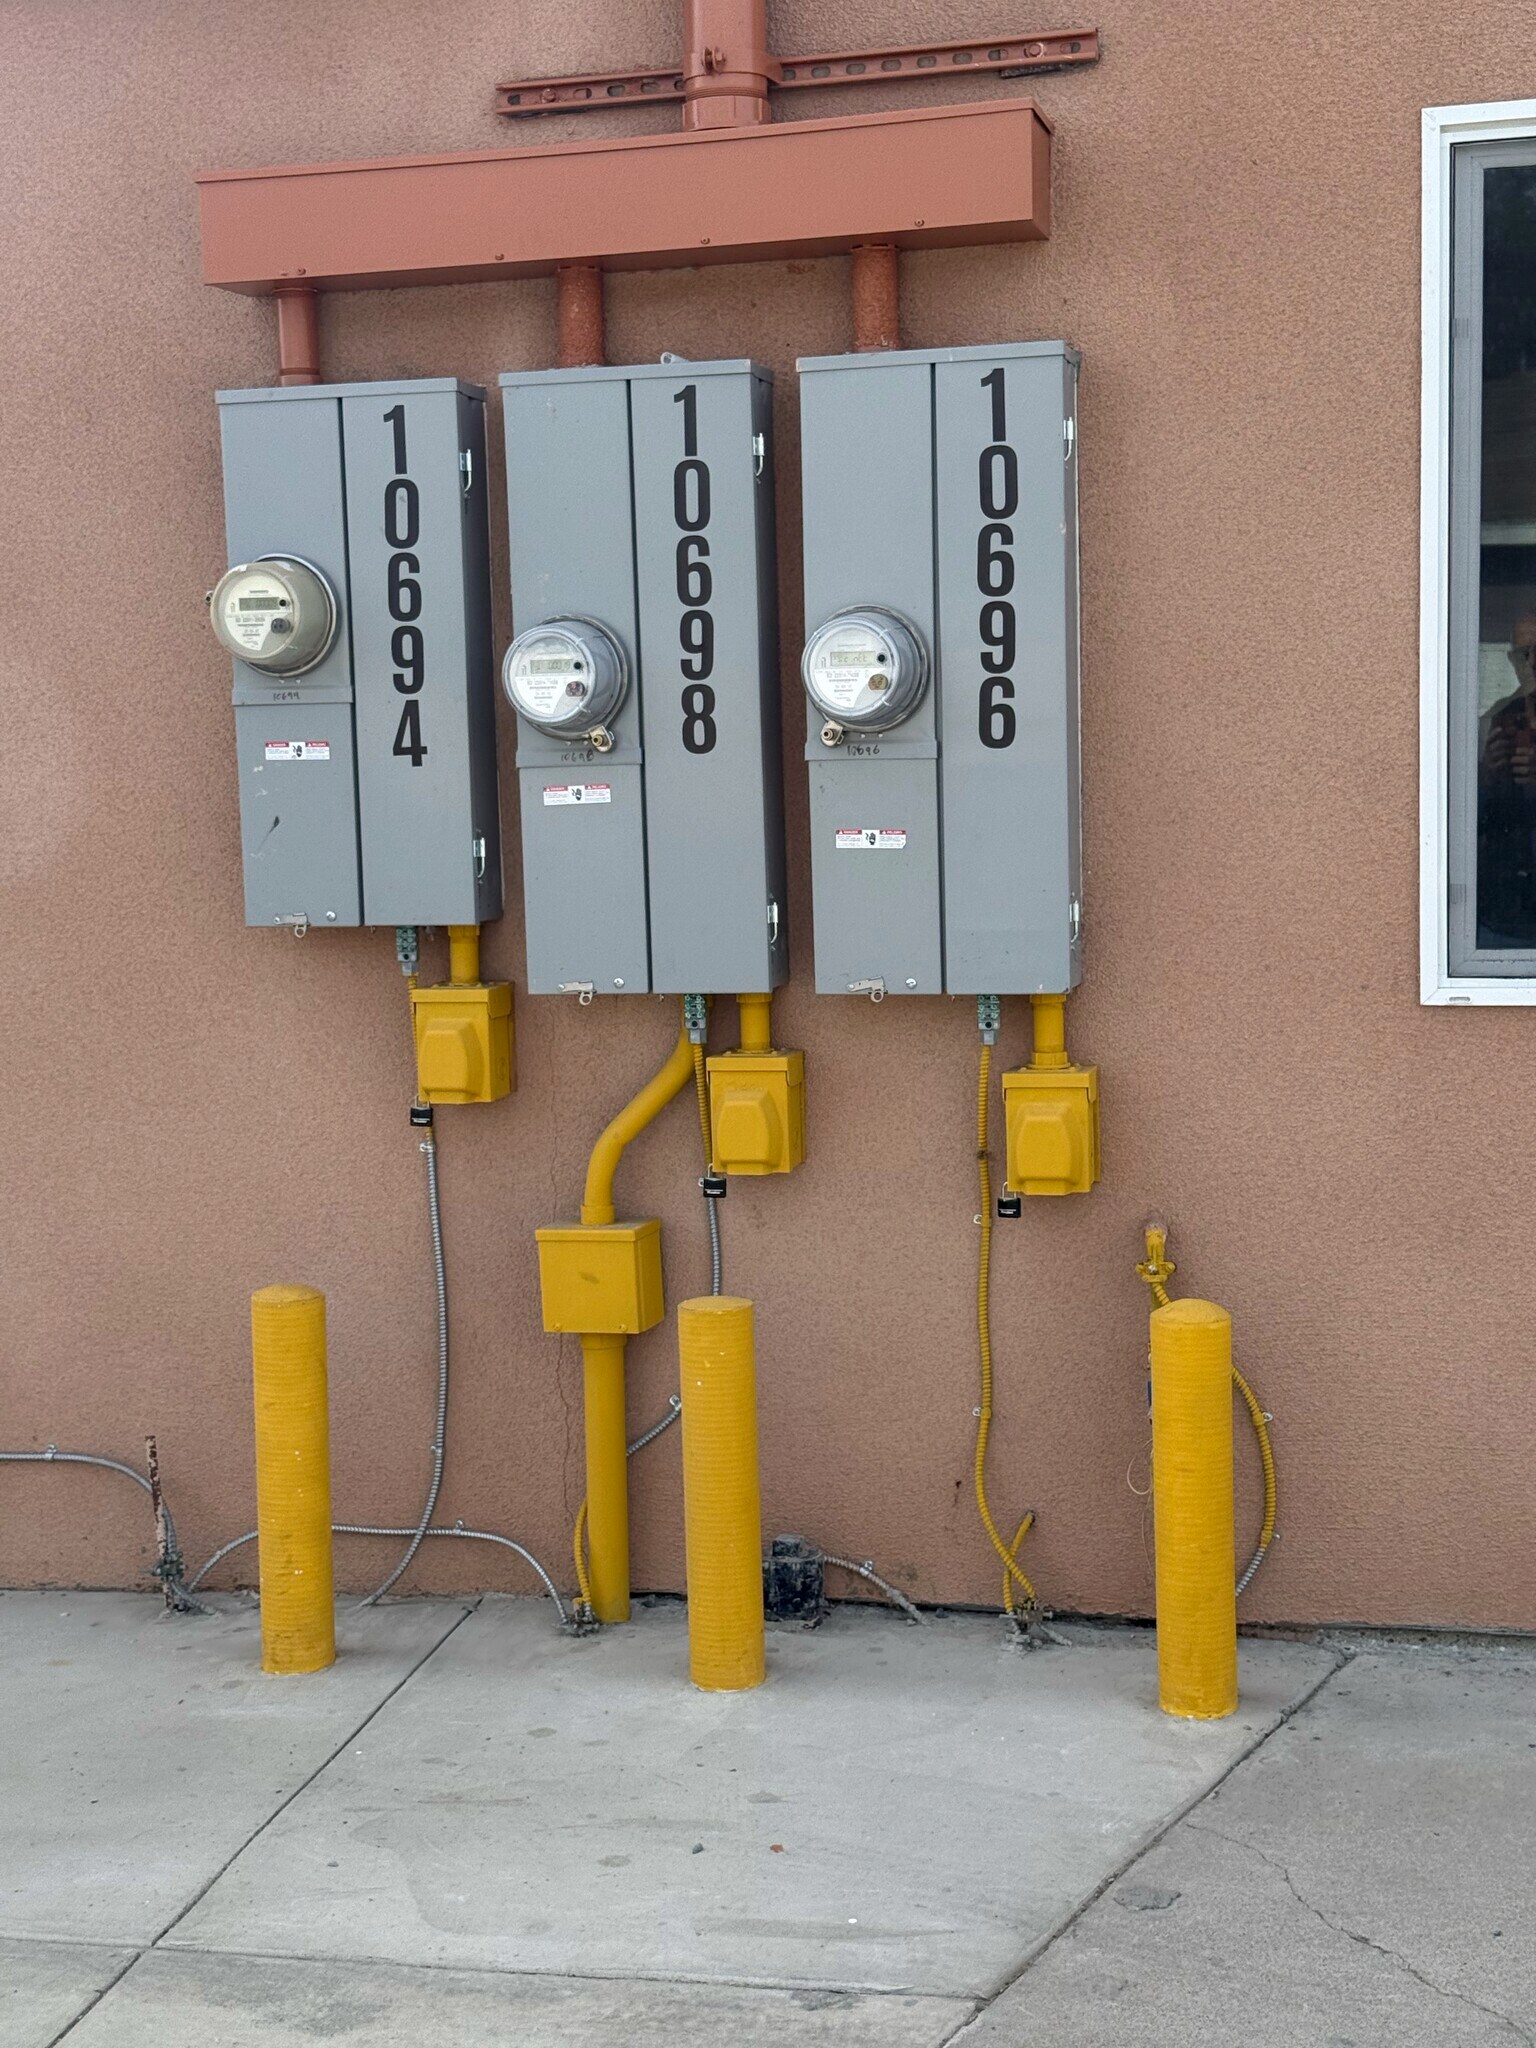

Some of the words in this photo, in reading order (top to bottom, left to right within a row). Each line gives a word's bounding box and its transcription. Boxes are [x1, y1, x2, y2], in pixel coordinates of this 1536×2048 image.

[383, 404, 428, 767] 10694
[673, 384, 717, 755] 10698
[977, 367, 1019, 749] 10696
